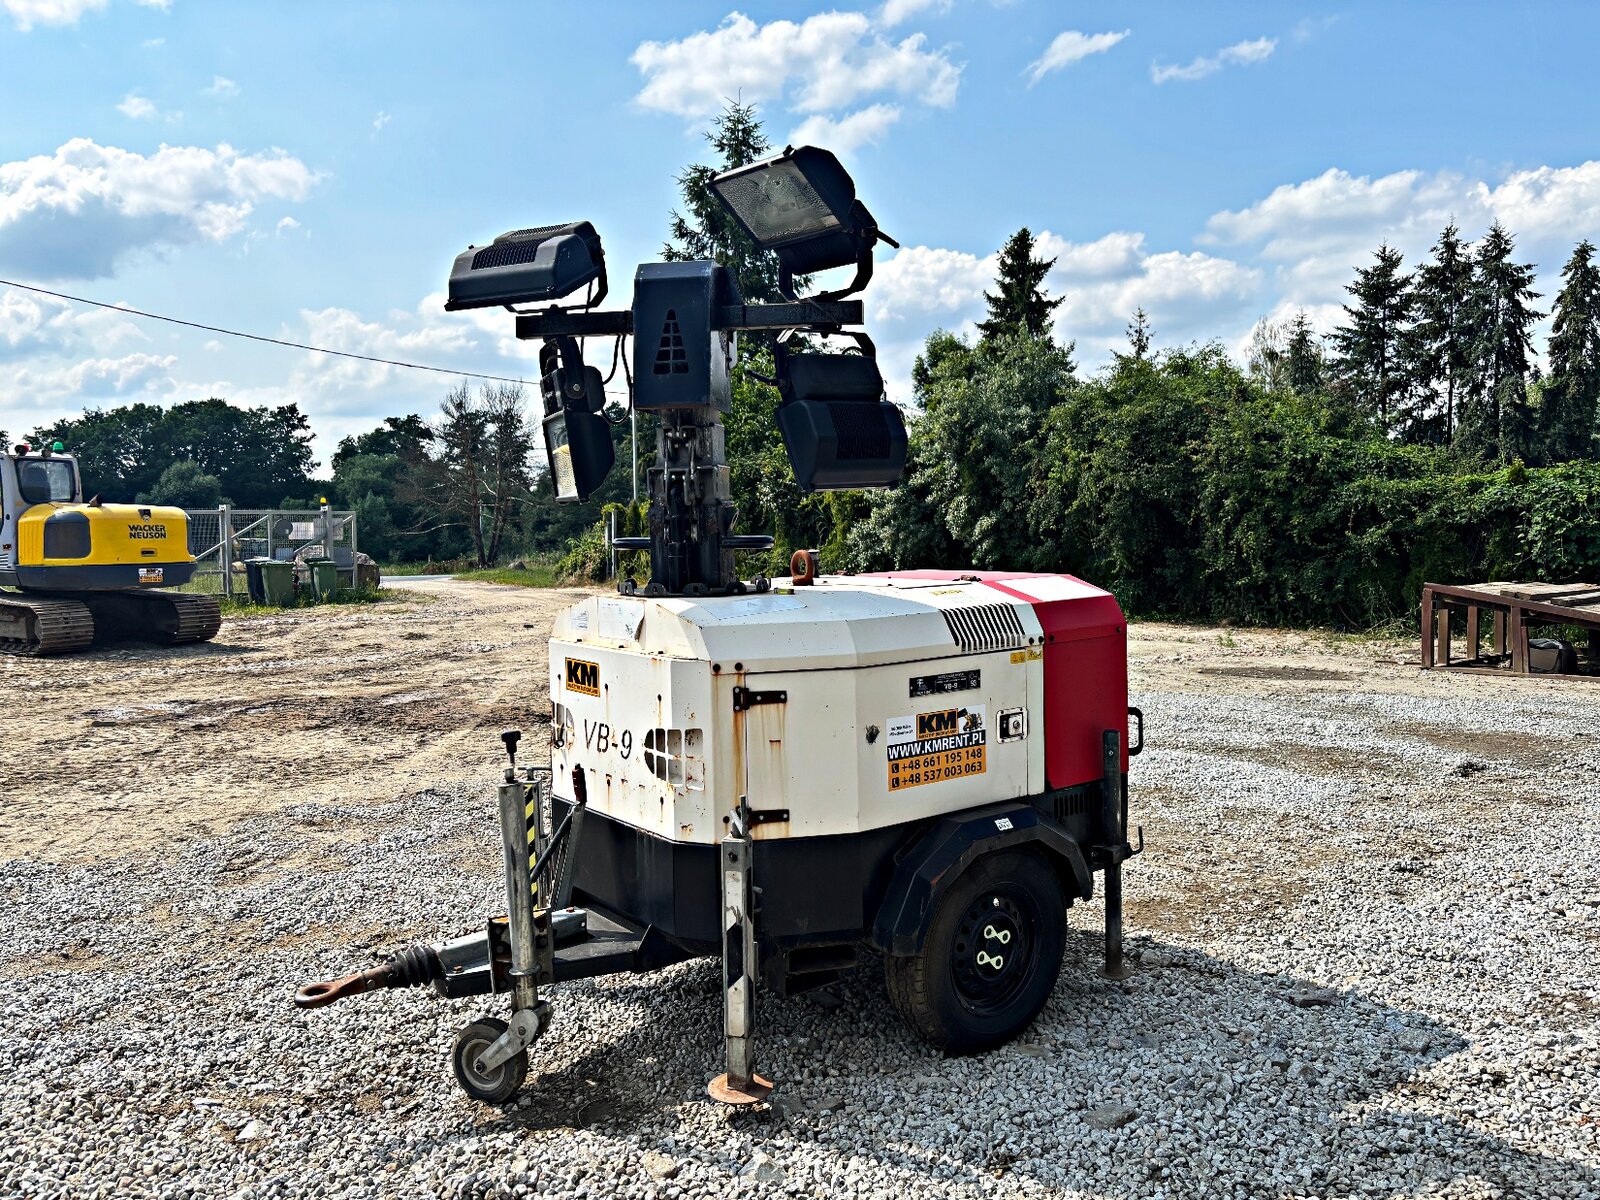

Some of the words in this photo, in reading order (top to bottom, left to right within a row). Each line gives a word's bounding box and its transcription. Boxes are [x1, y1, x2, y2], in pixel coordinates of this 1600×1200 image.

[567, 660, 598, 688] KM
[919, 711, 957, 734] KM
[584, 719, 632, 760] VB-9
[887, 732, 985, 760] WWW.KMRENT.PL
[901, 759, 920, 772] +48
[923, 755, 940, 768] 661
[945, 751, 962, 764] 195
[965, 747, 982, 760] 148
[901, 772, 920, 785] +48
[923, 768, 941, 781] 537
[944, 765, 962, 777] 003
[965, 761, 982, 774] 063
